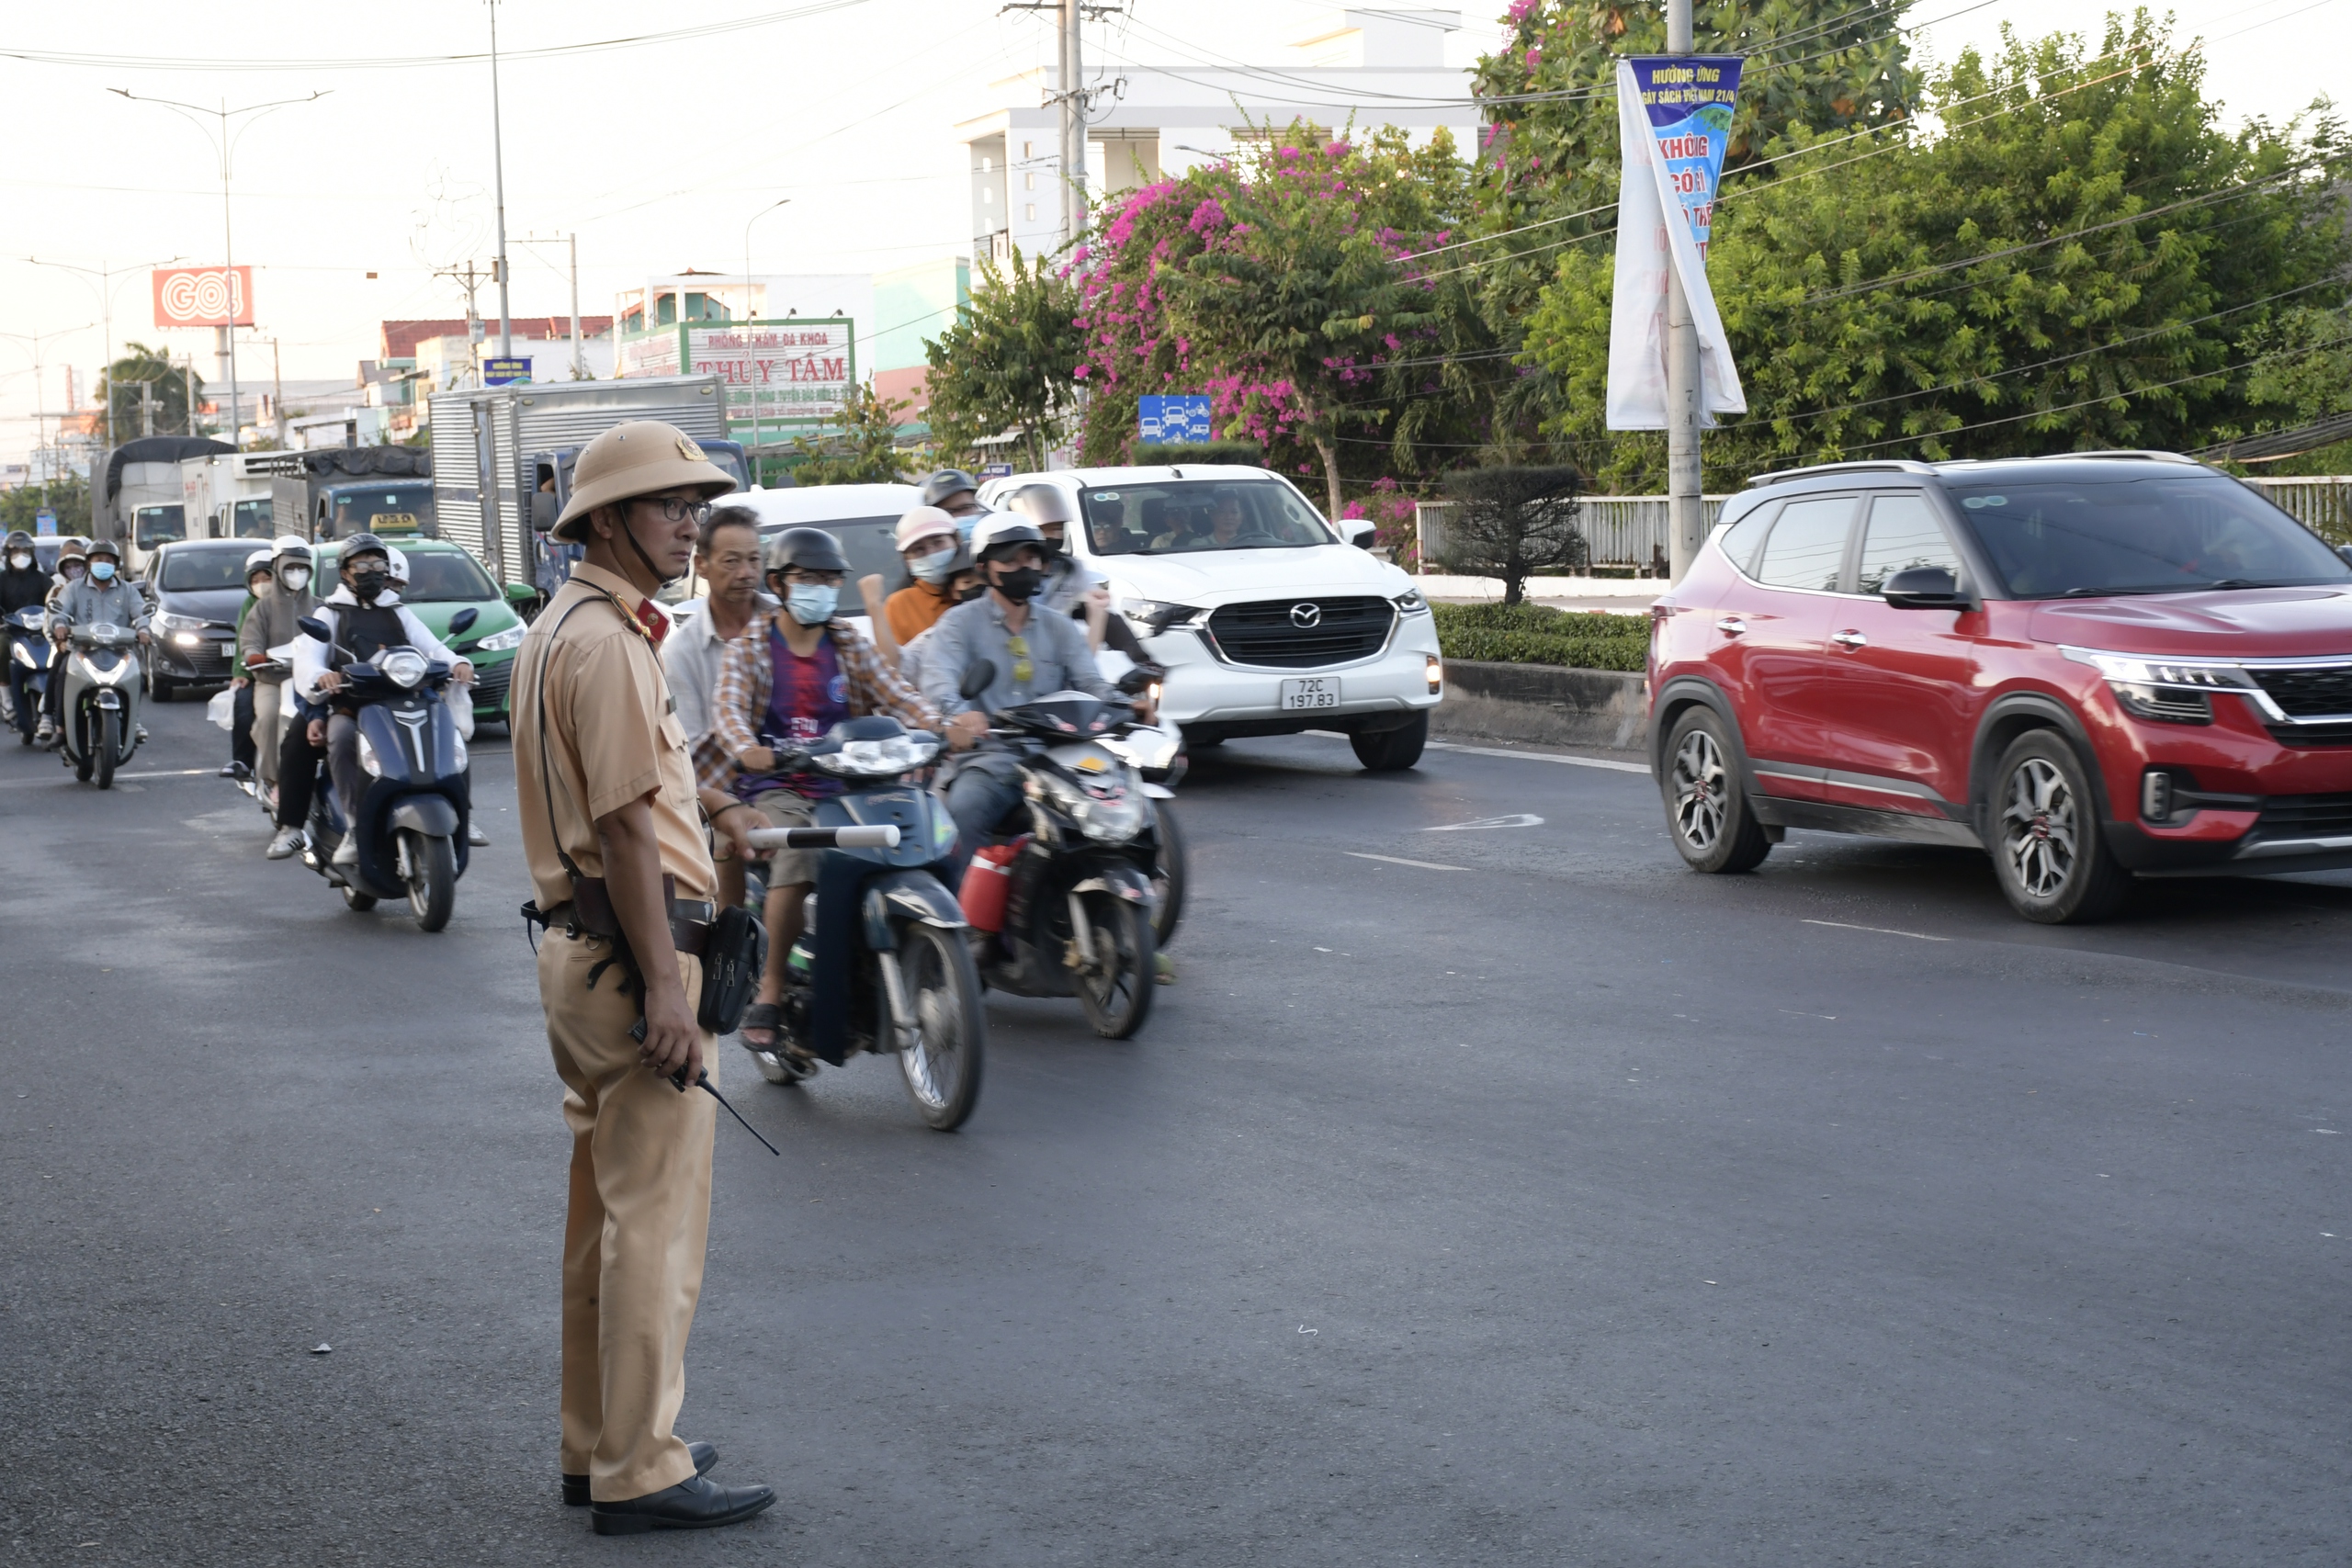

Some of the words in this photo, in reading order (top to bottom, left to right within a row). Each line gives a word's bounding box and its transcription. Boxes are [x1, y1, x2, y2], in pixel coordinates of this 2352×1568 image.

[1652, 64, 1694, 85] HƯỞNG
[1696, 65, 1721, 83] ỨNG
[1642, 89, 1657, 105] GÀY
[1658, 88, 1681, 104] SÁCH
[1715, 89, 1735, 103] 21/4
[800, 333, 828, 345] KHOA
[786, 352, 844, 381] TÂM
[1299, 680, 1323, 693] 72C
[1290, 694, 1334, 707] 197.83
